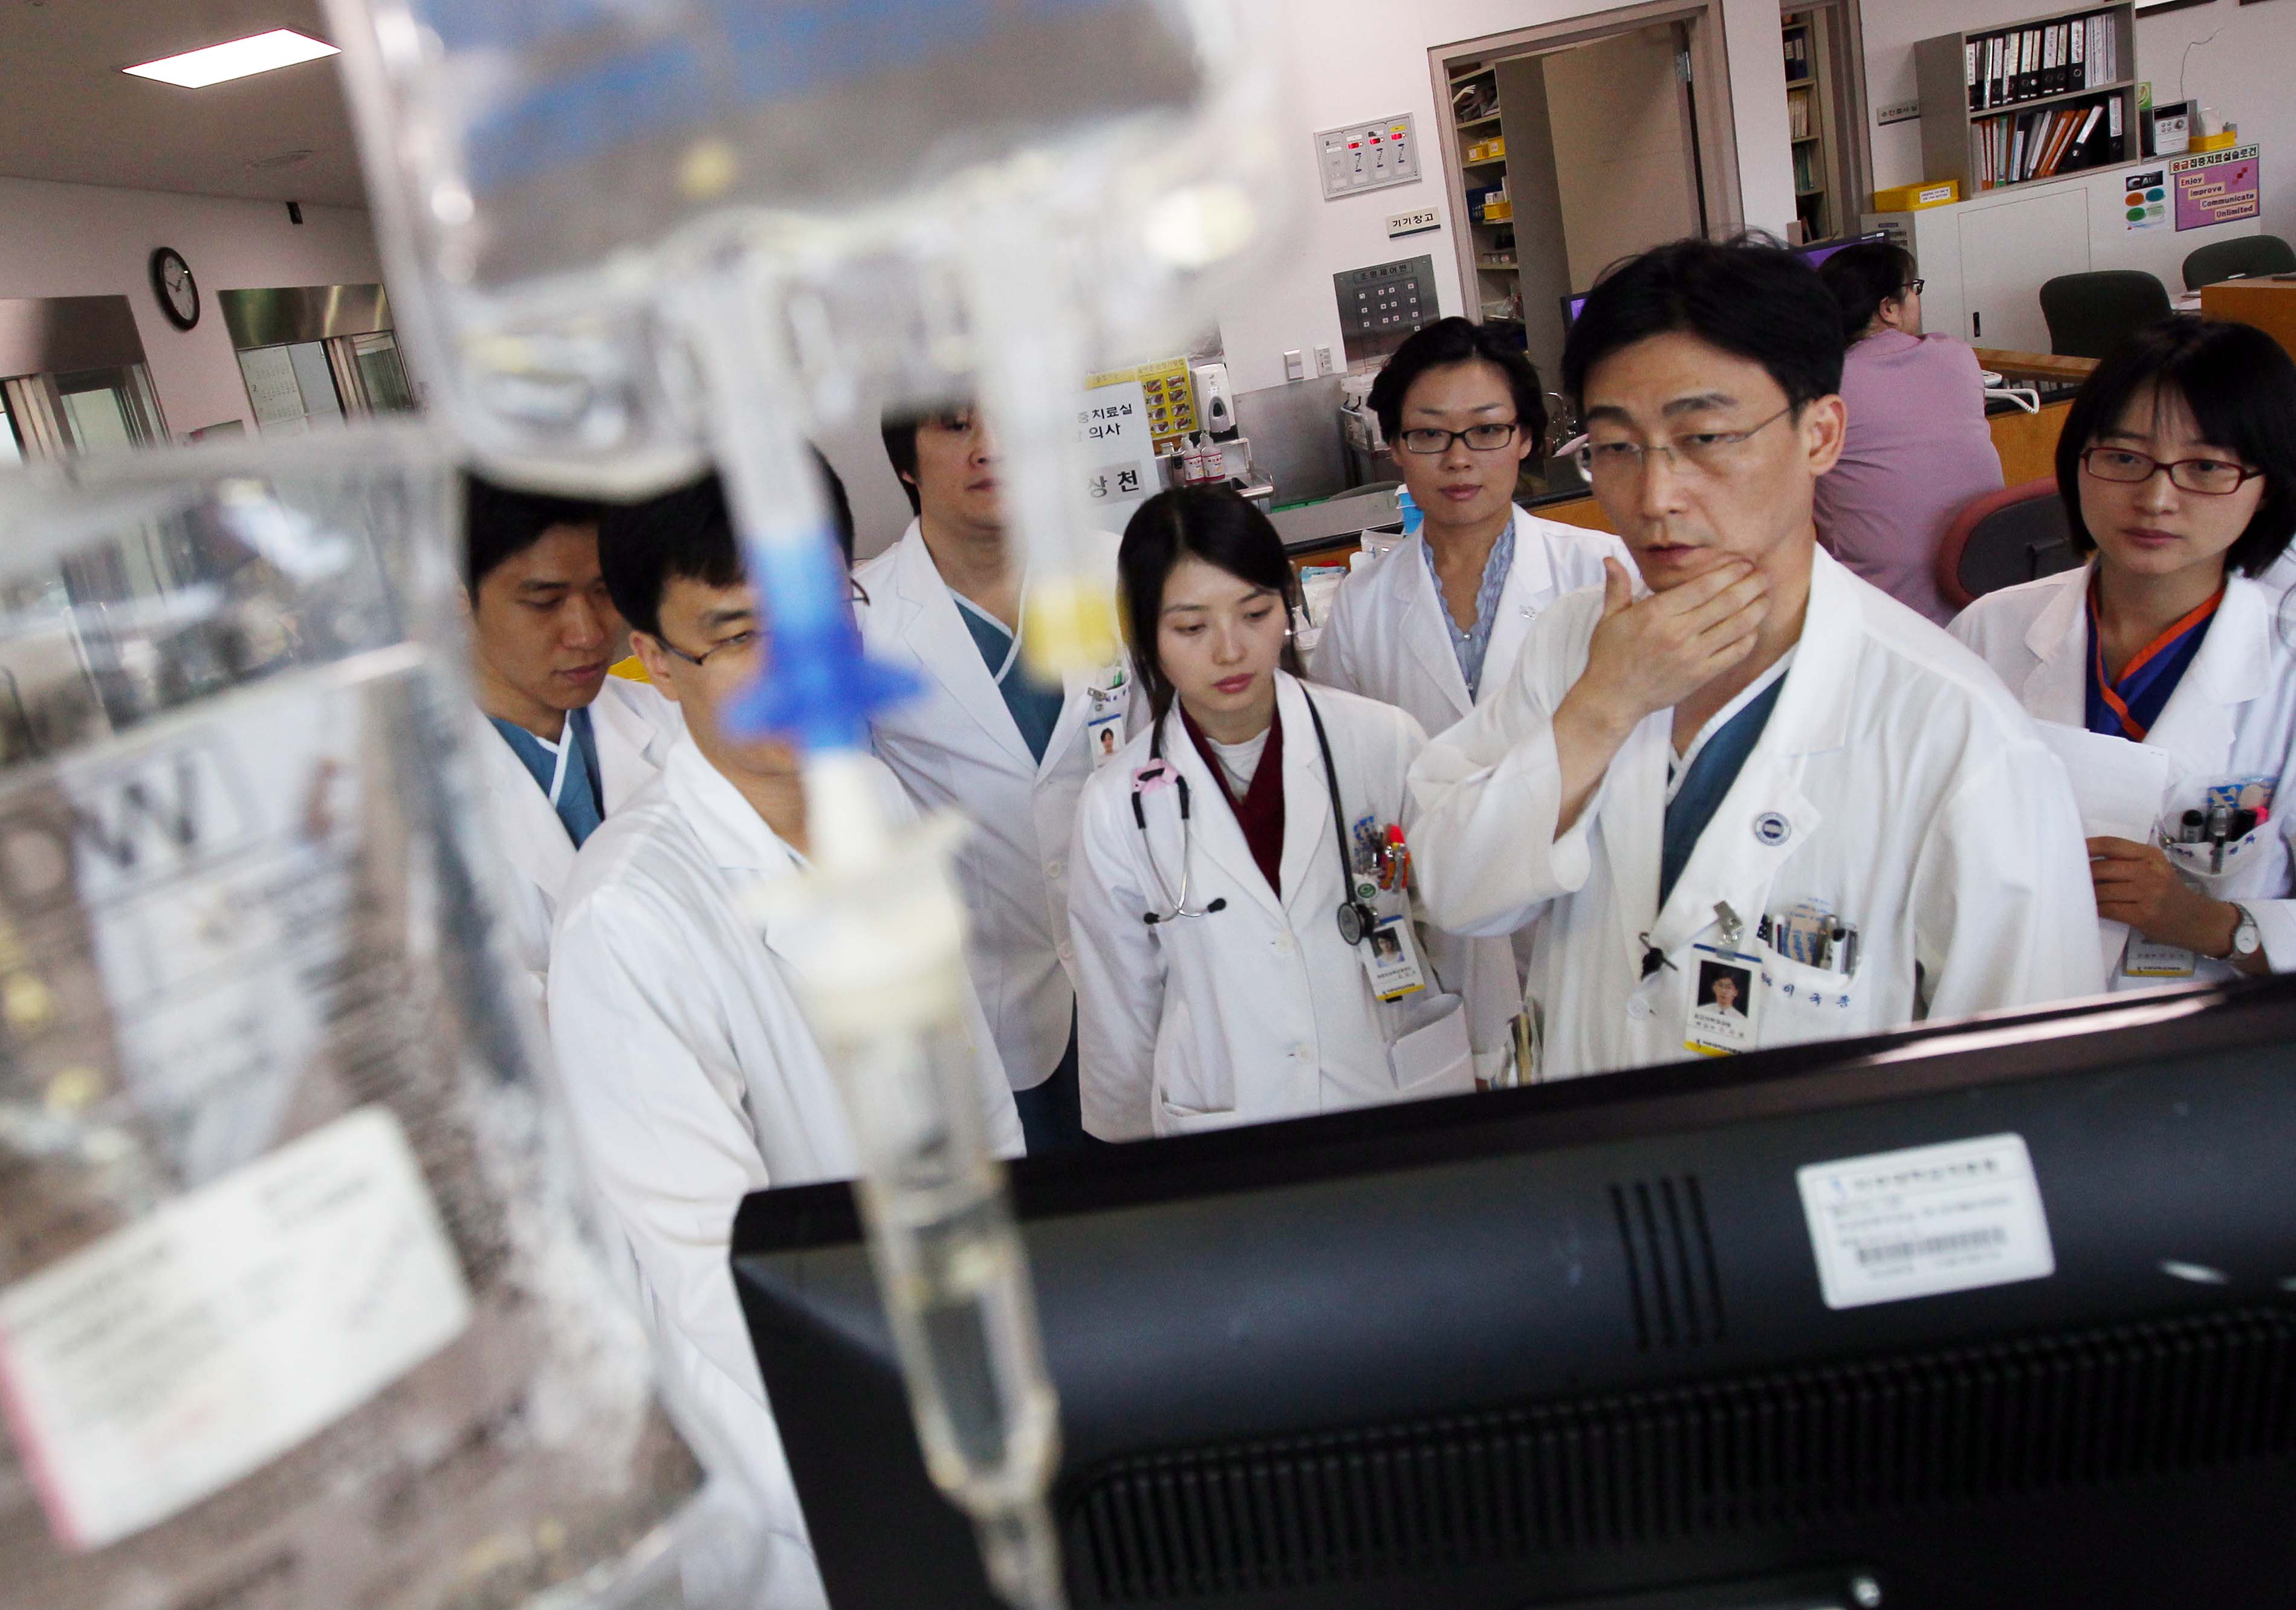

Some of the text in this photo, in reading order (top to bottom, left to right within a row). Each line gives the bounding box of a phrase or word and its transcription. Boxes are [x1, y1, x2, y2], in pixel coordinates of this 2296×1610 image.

[2181, 177, 2202, 187] Enjoy
[2190, 186, 2222, 197] Improve
[2202, 193, 2254, 208] Communicate
[2216, 205, 2253, 218] Unlimited
[1392, 213, 1433, 227] 기기창고
